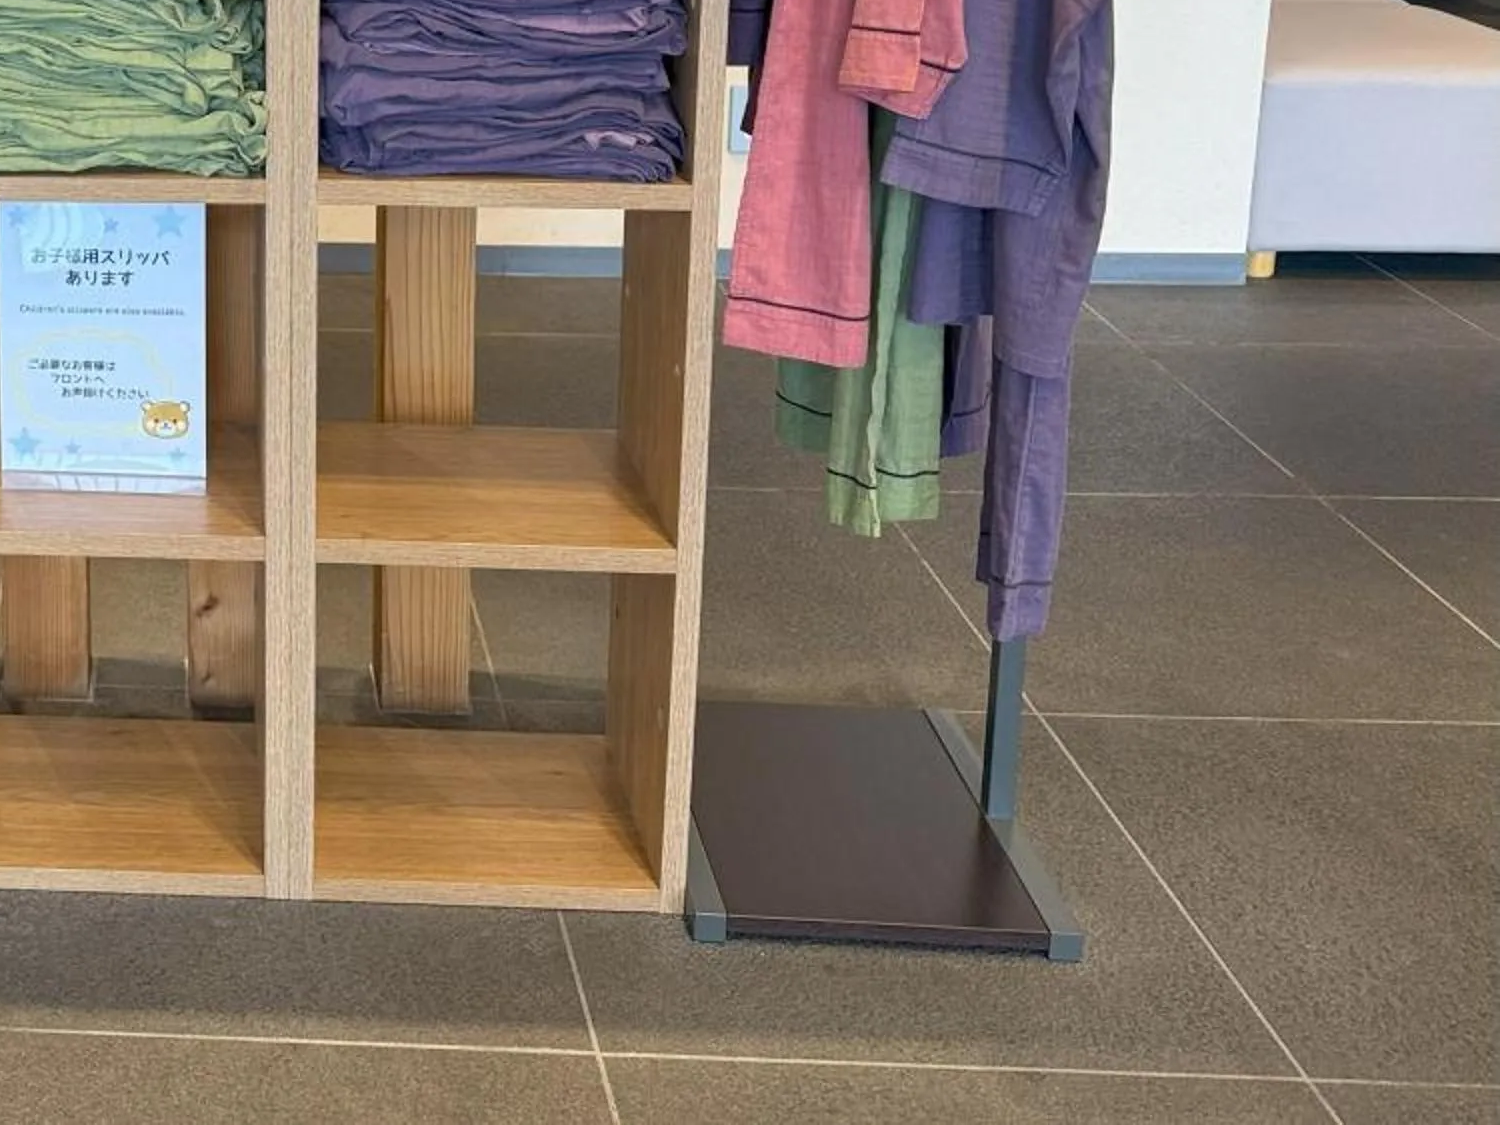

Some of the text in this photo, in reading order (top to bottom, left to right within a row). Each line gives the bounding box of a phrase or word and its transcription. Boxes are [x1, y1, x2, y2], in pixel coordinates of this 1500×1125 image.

[31, 248, 170, 266] お子様用スリッパ
[65, 269, 134, 287] あります
[50, 373, 106, 385] フロントへ
